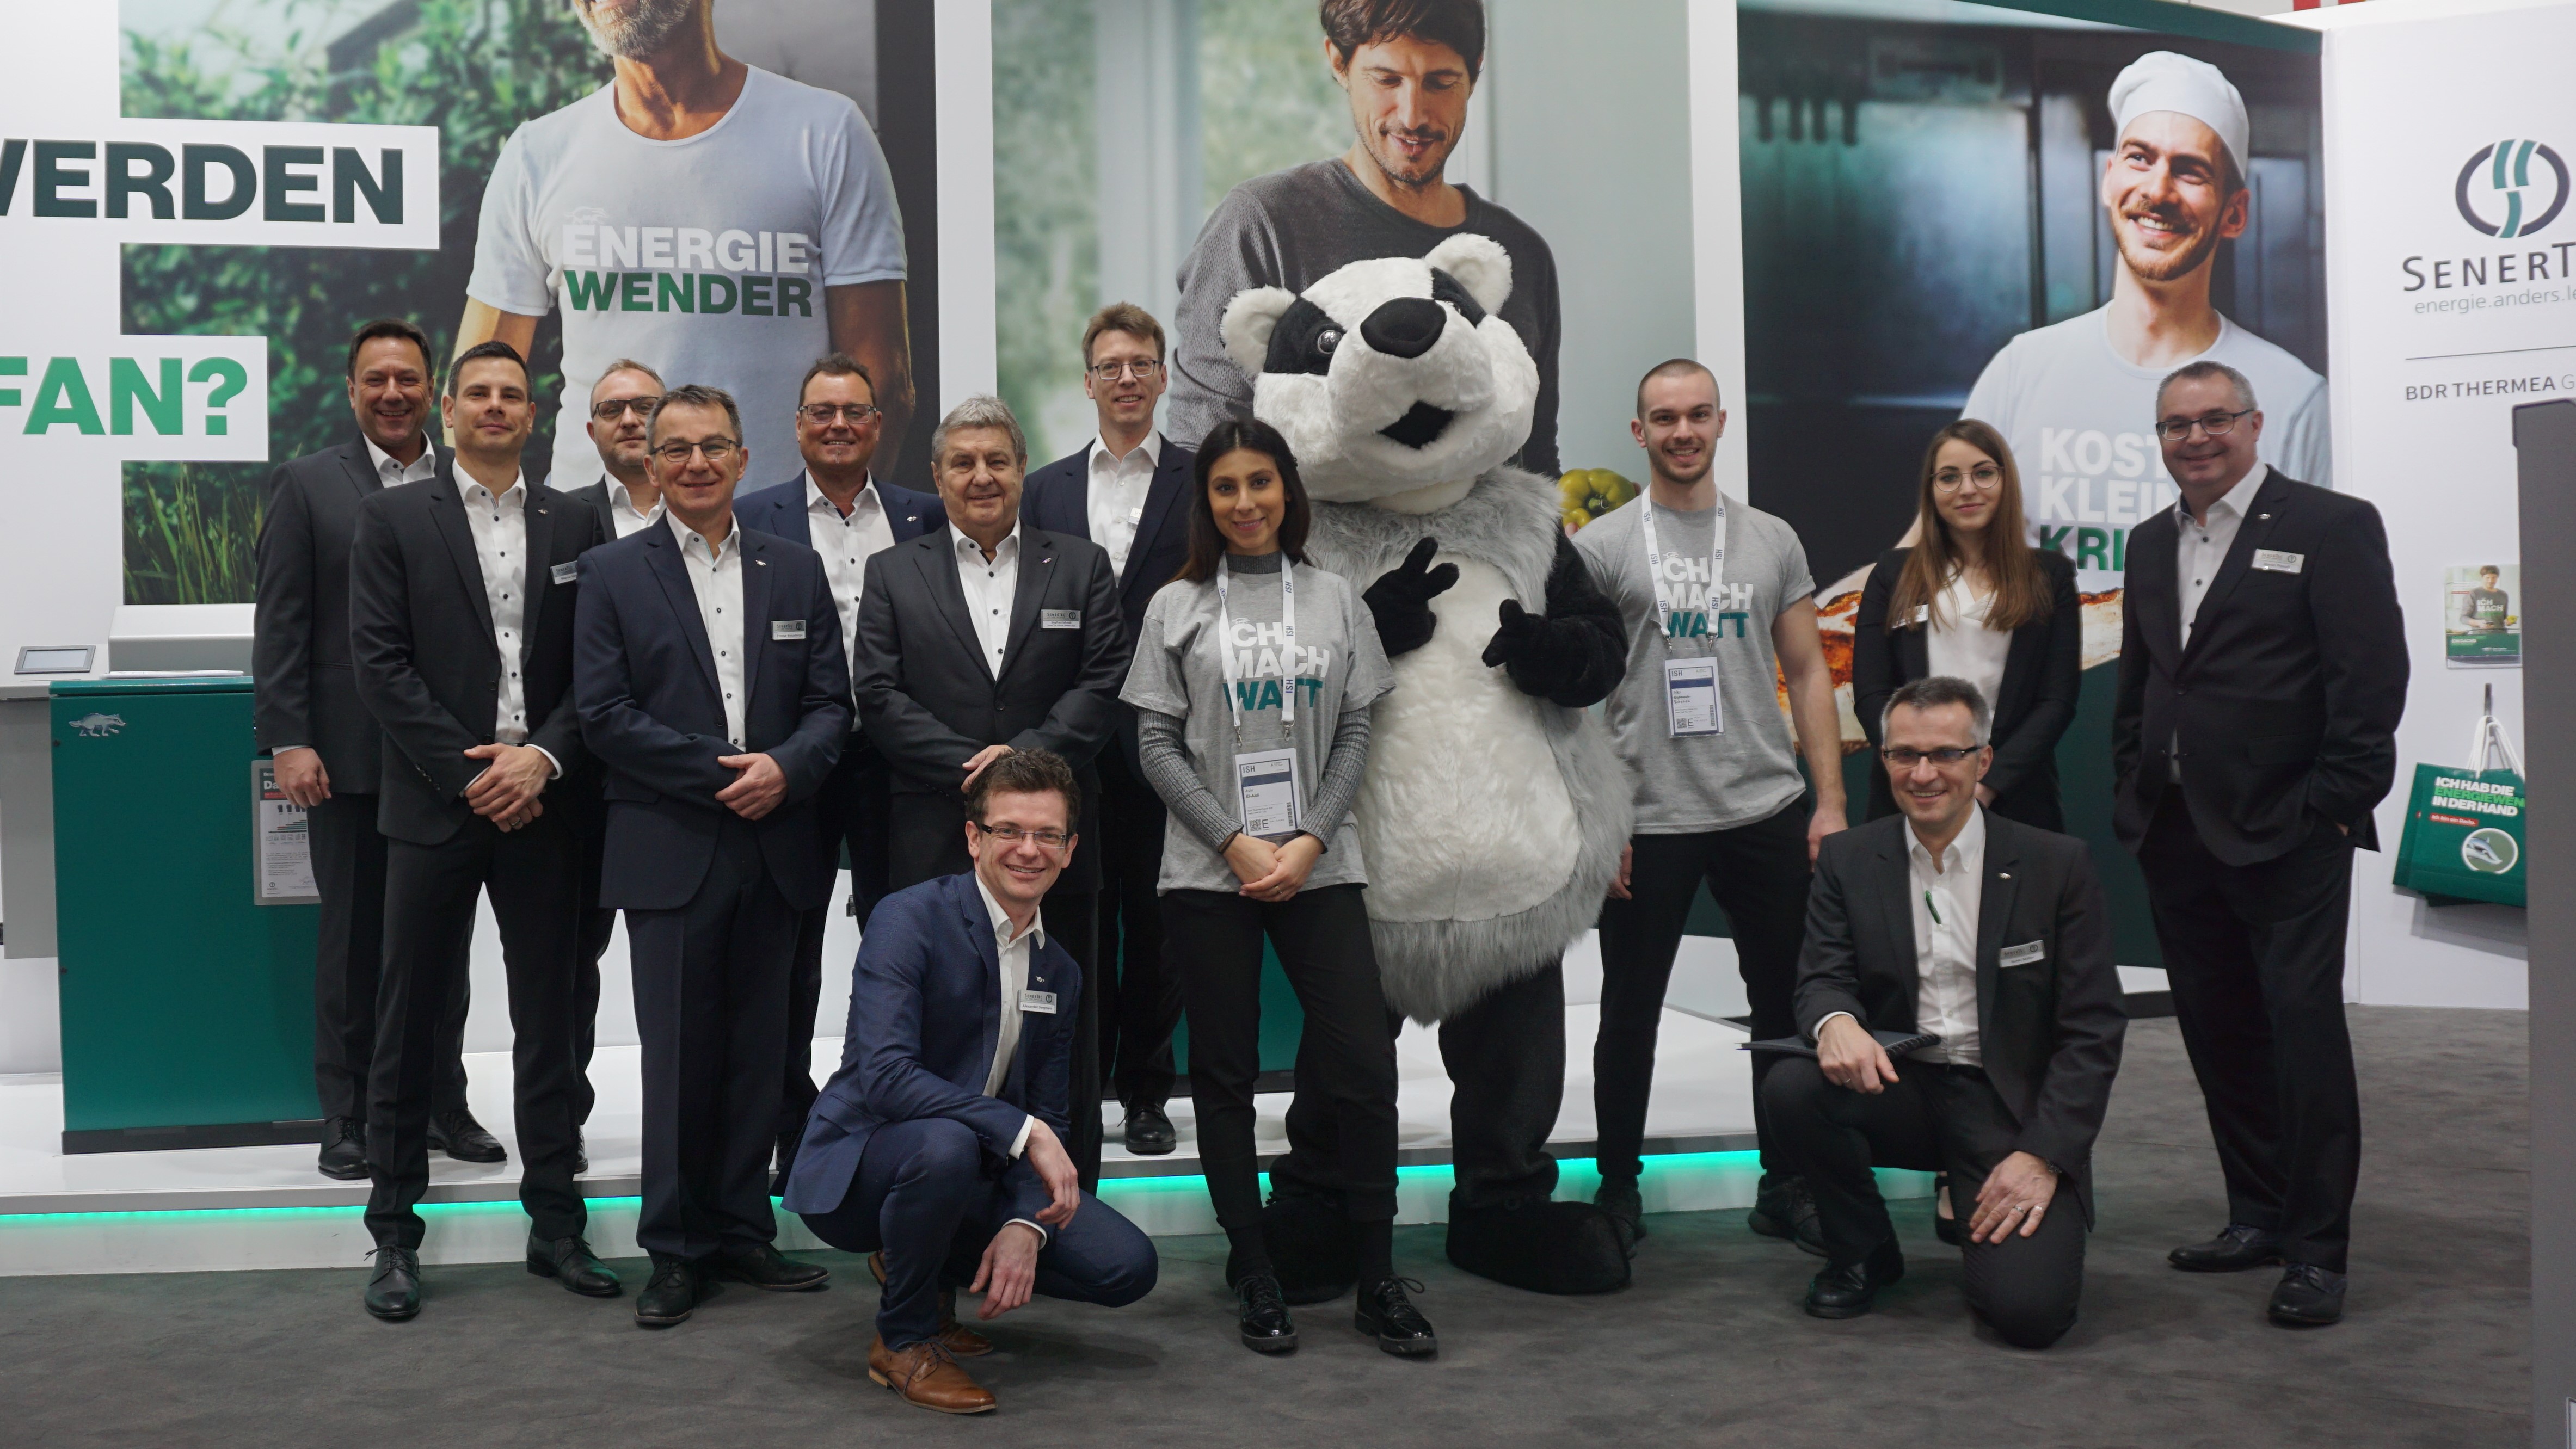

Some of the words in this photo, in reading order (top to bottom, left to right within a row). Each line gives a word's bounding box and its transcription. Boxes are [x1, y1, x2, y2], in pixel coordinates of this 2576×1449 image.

[562, 224, 809, 273] ENERGIE
[564, 269, 812, 317] WENDER
[2406, 384, 2448, 400] BDR
[2452, 376, 2556, 397] THERMEA
[2561, 374, 2575, 390] G
[1650, 553, 1659, 564] ISH
[2040, 524, 2132, 571] KRI
[1662, 557, 1710, 582] CH
[1659, 600, 1668, 612] ISH
[1664, 583, 1753, 610] MACH
[1230, 622, 1284, 647] CH
[1667, 612, 1749, 638] WATT
[1688, 718, 1694, 726] E
[2436, 776, 2460, 788] ICH
[2461, 780, 2489, 793] HAB
[2491, 784, 2515, 796] DIE
[2432, 796, 2448, 806] IN
[2448, 798, 2476, 811] DER
[2477, 802, 2518, 816] HAND
[1262, 819, 1269, 828] E
